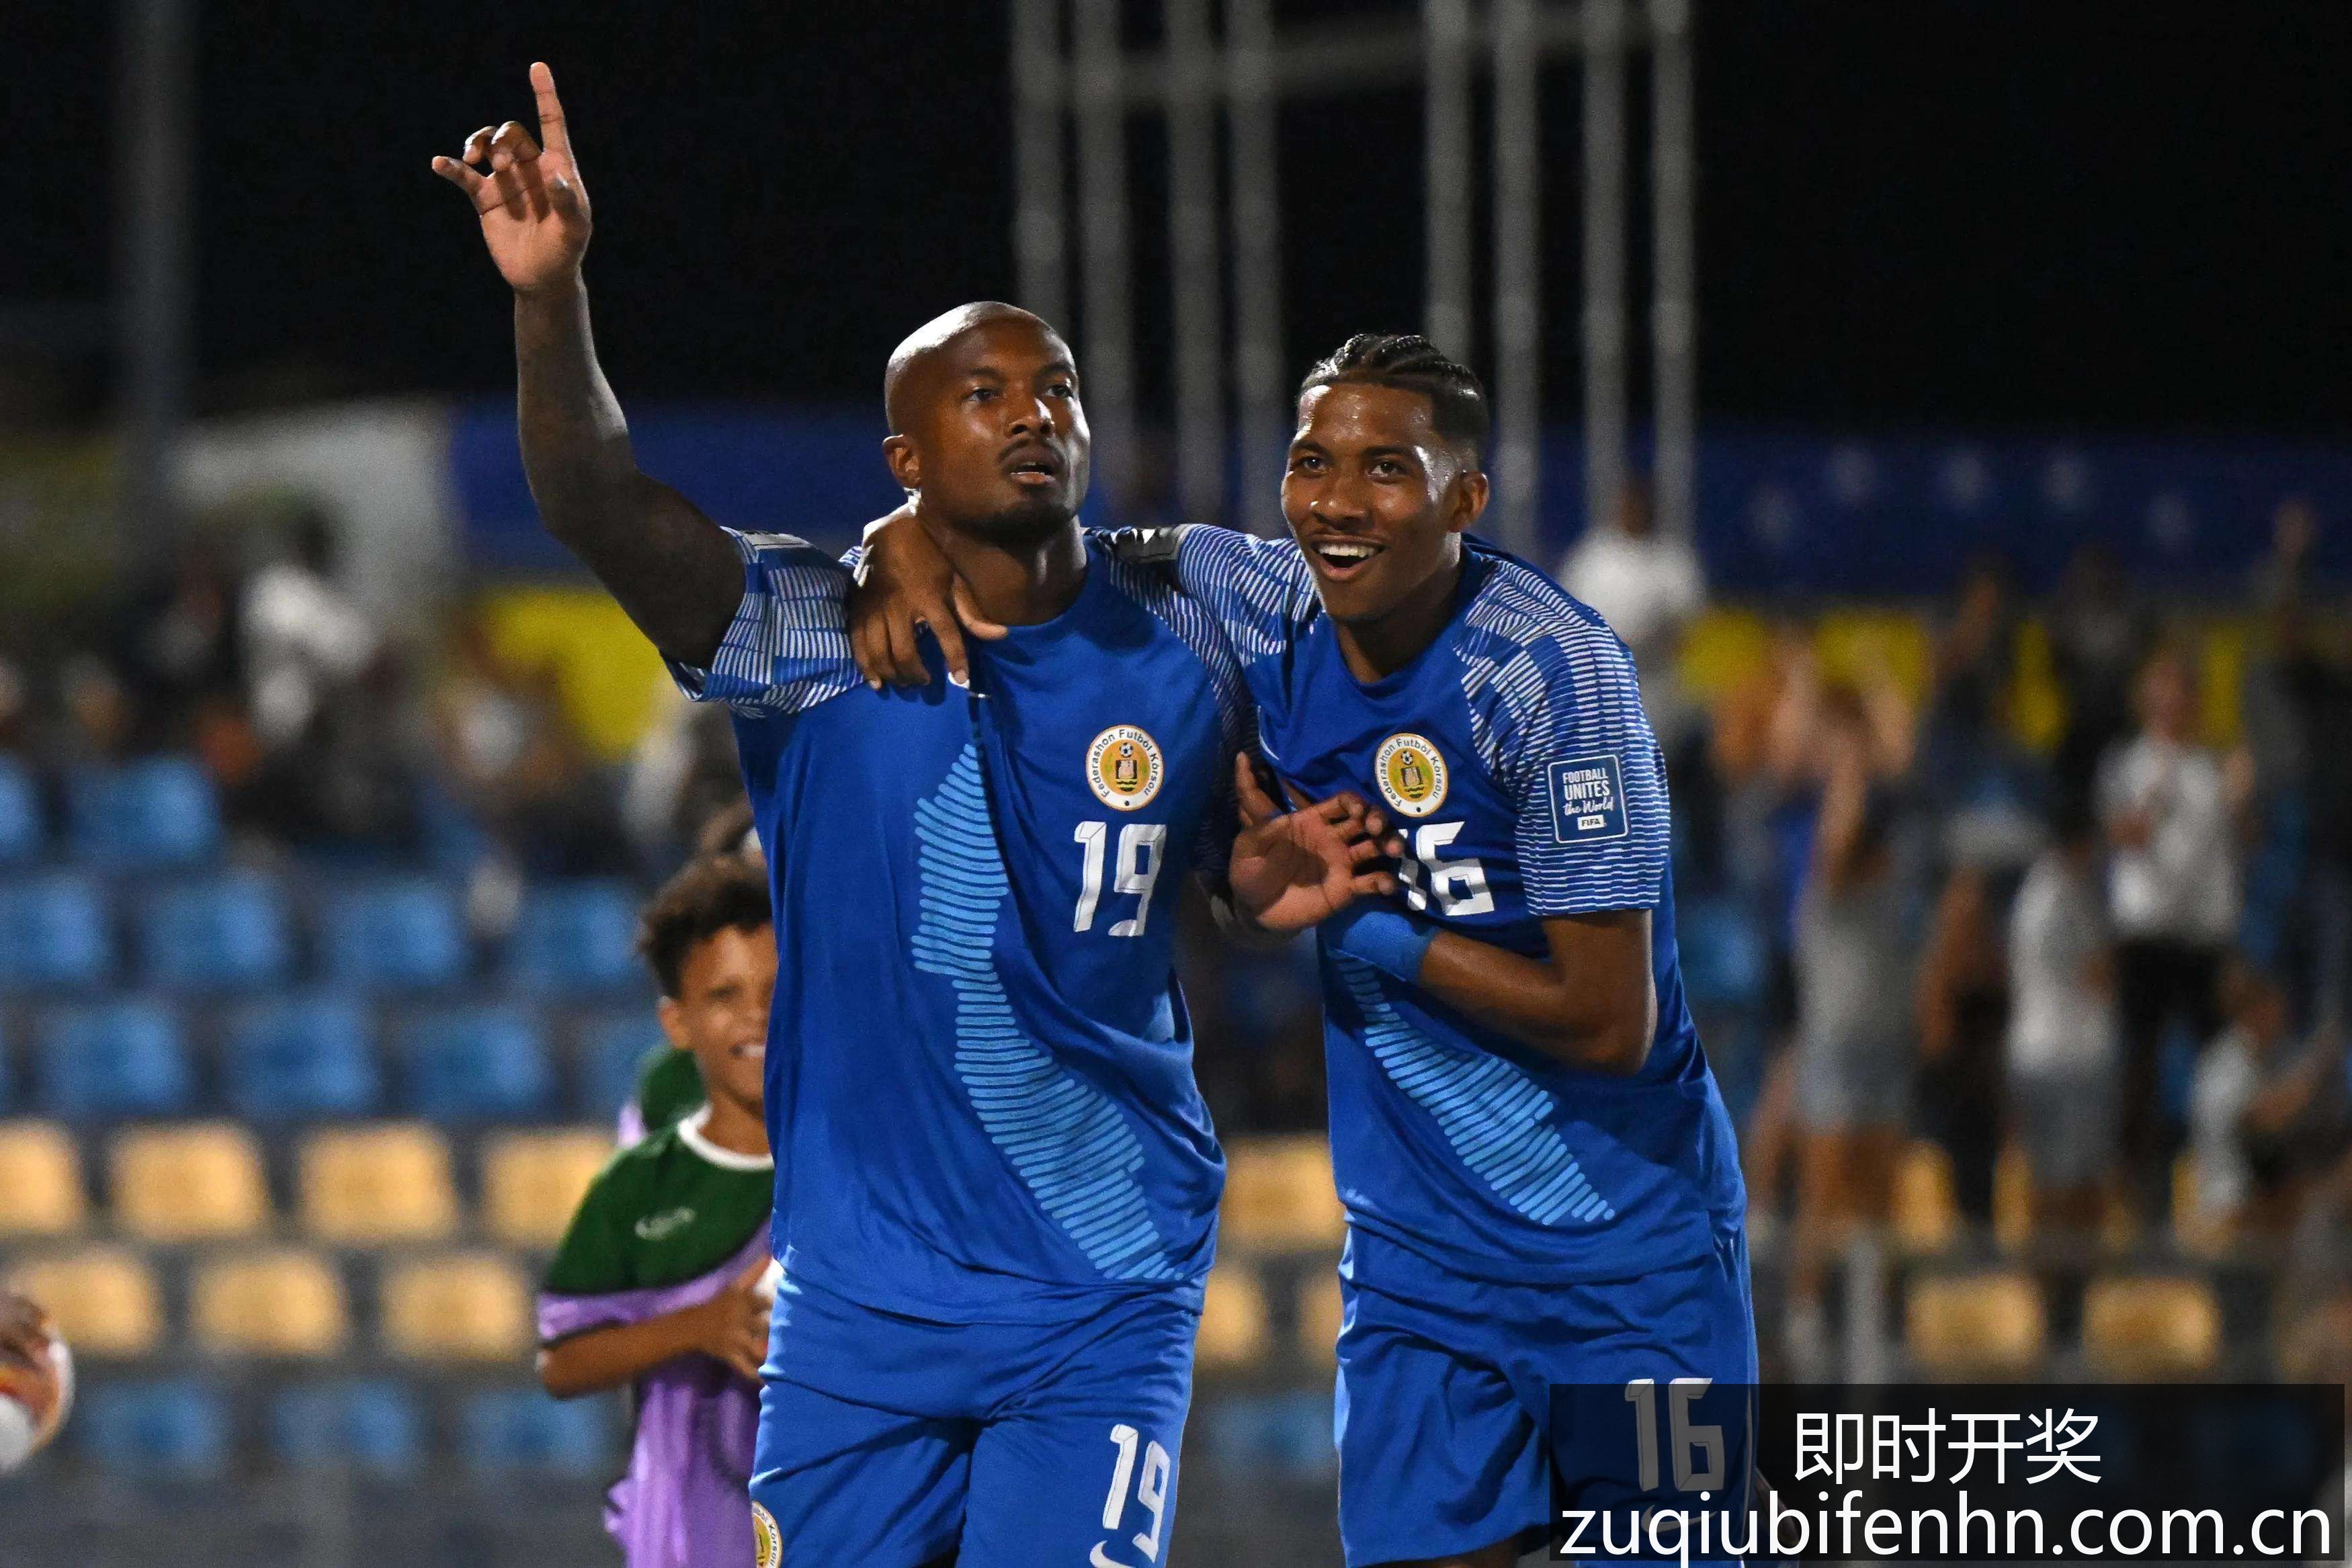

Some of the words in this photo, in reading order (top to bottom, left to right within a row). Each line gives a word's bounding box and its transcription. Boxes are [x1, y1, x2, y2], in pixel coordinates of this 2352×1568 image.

[1091, 734, 1116, 797] Federashon
[1562, 767, 1609, 784] FOOTBALL
[1562, 800, 1581, 816] the
[1583, 796, 1614, 813] World
[1564, 779, 1611, 801] UNITES
[1581, 818, 1601, 827] FIFA
[1074, 820, 1167, 937] 19
[1624, 1377, 1725, 1492] 16
[1102, 1424, 1171, 1564] 19
